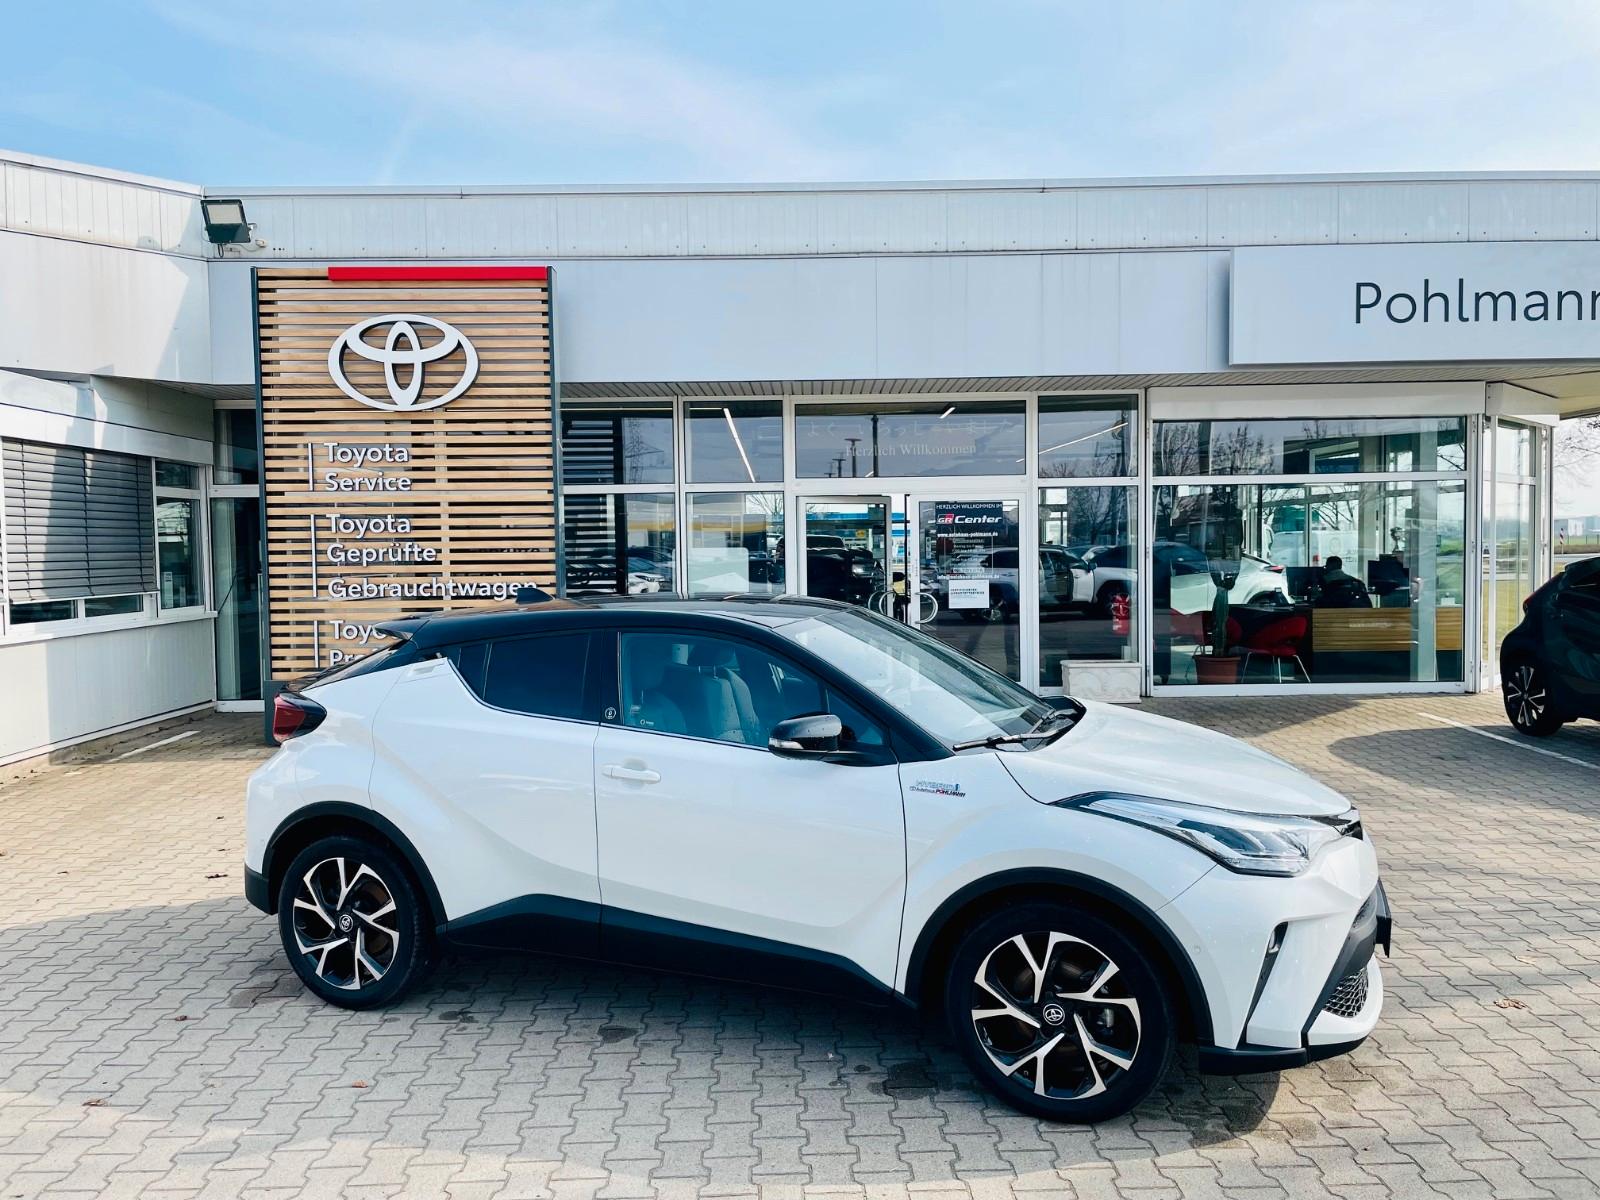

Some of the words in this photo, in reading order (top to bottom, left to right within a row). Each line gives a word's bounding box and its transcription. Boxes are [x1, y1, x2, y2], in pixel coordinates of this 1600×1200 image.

[323, 442, 410, 468] Toyota
[900, 443, 977, 456] Willkommen
[324, 472, 412, 492] Service
[325, 513, 411, 539] Toyota
[954, 514, 1003, 524] Center
[326, 542, 437, 567] Geprüfte
